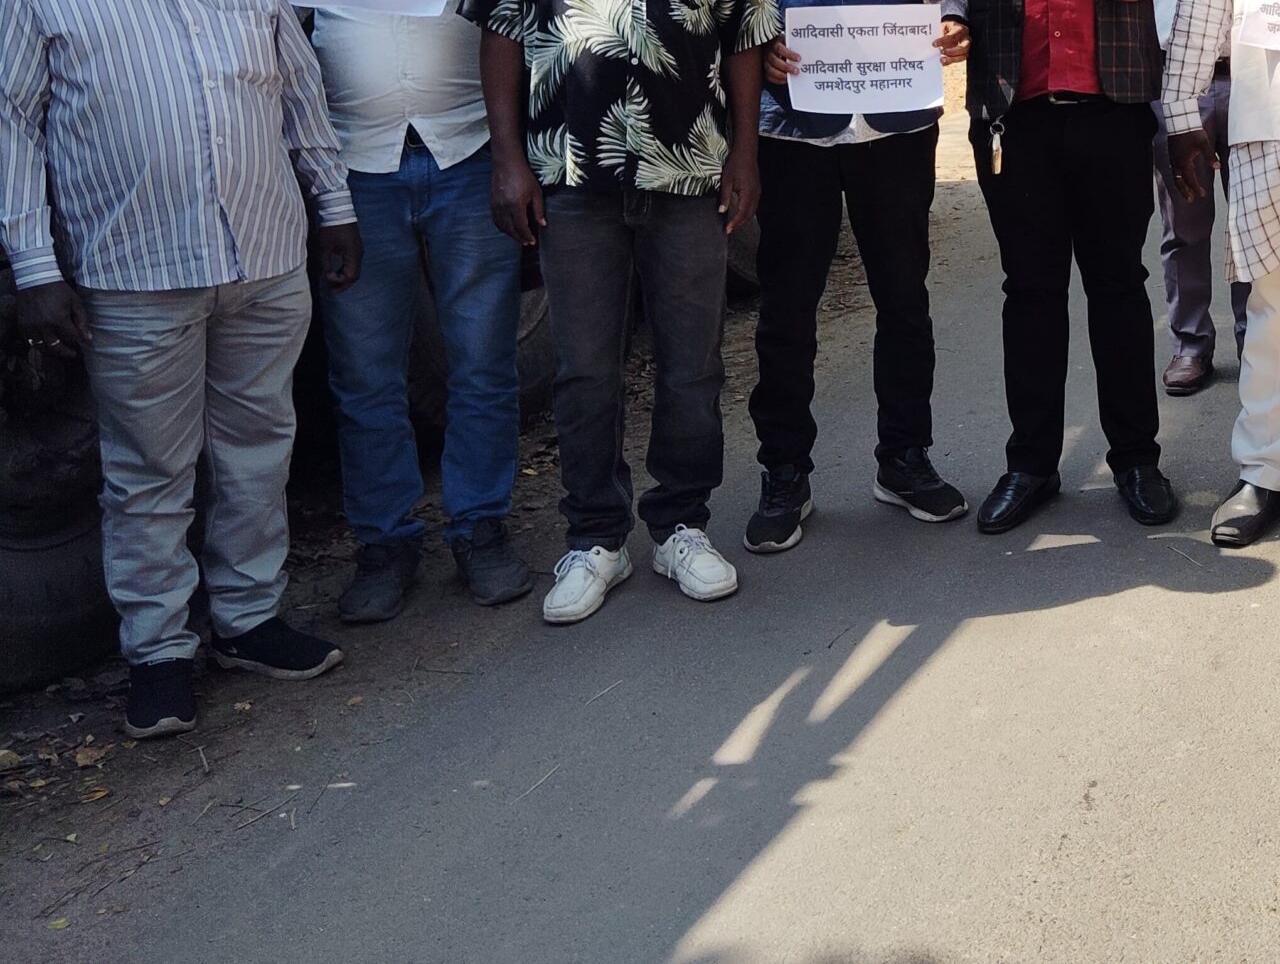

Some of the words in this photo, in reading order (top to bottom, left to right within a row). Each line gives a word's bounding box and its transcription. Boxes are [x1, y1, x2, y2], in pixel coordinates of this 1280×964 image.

[791, 23, 844, 38] आदिवासी
[848, 25, 879, 39] एकता
[882, 23, 932, 36] जिंदाबाद!
[800, 59, 852, 74] आदिवासी
[856, 62, 886, 76] सुरक्षा
[890, 58, 924, 72] परिषद
[814, 77, 865, 93] जमशेदपुर
[870, 78, 912, 91] महानगर
